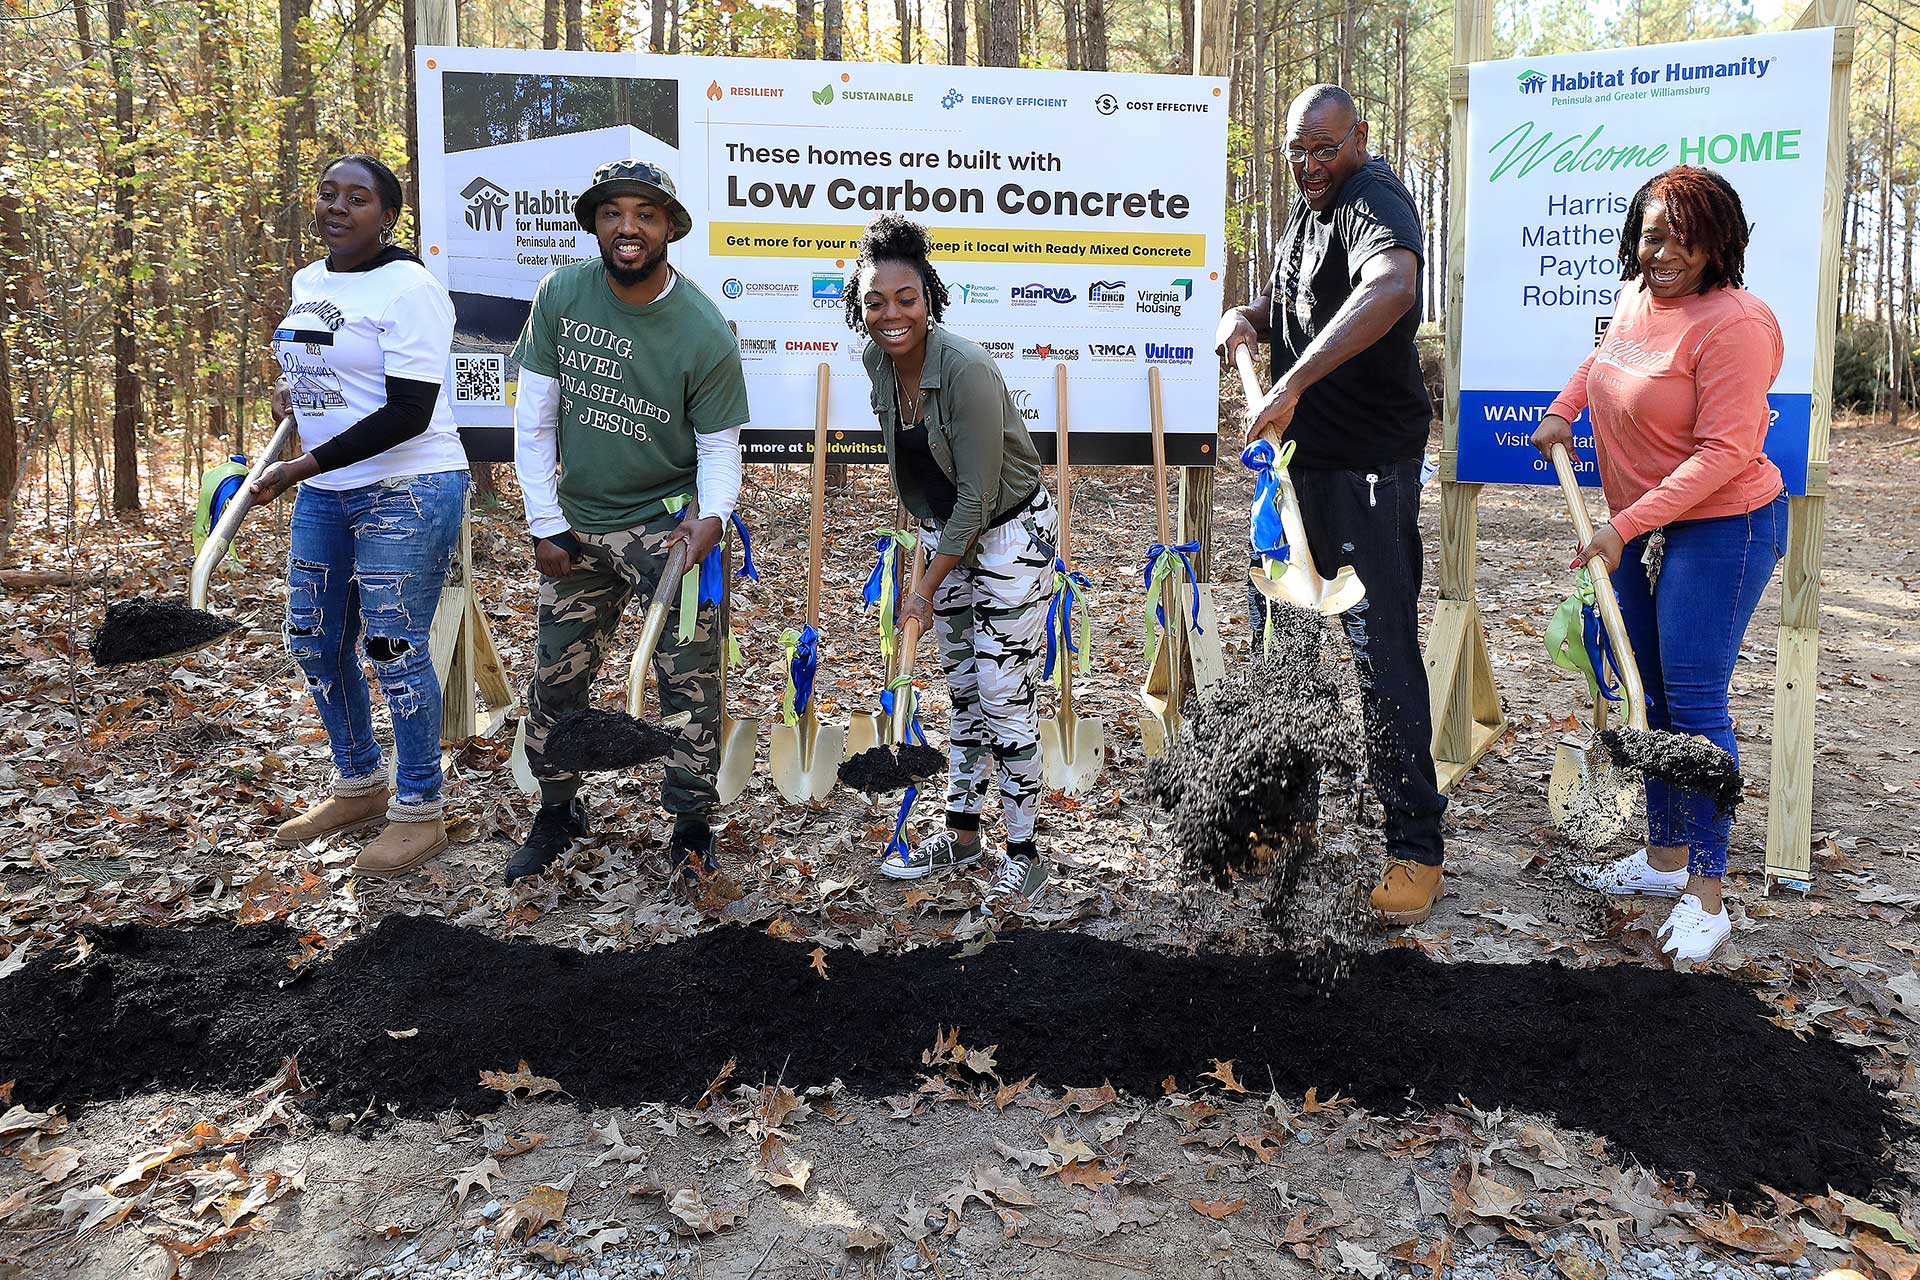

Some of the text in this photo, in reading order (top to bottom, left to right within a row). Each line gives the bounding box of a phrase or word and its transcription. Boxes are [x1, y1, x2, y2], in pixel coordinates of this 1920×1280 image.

[1551, 70, 1625, 92] Habitat
[1631, 67, 1660, 86] for
[730, 87, 784, 98] RESILIENT
[842, 91, 914, 102] SUSTAINABLE
[1551, 85, 1711, 106] Peninsula and Greater Williamsburg
[971, 95, 1068, 108] ENERGY EFFICIENT
[1126, 101, 1209, 113] COST EFFECTIVE
[726, 143, 1062, 172] These homes are built with
[1488, 121, 1802, 183] Welcome HOME
[515, 189, 579, 215] Habit
[727, 175, 1190, 219] Low Carbon Concrete
[1548, 192, 1628, 216] Harris
[515, 218, 583, 231] for Human
[516, 235, 576, 248] Peninsula and
[1522, 223, 1621, 247] Matthe
[726, 235, 750, 247] Get
[753, 238, 788, 248] more
[793, 236, 812, 248] for
[816, 239, 846, 251] your
[964, 240, 973, 252] it
[977, 241, 1009, 253] local
[1012, 242, 1042, 254] with
[1046, 243, 1087, 256] Ready
[1089, 244, 1129, 256] Mixed
[1132, 245, 1191, 257] Concrete
[517, 253, 548, 265] Greater
[745, 283, 800, 292] CONSOCIATE
[1011, 286, 1075, 302] PlanRVA
[813, 300, 843, 309] CPDC
[1101, 293, 1125, 302] DHCD
[1137, 290, 1179, 305] Virginia
[1136, 302, 1182, 317] Housing
[785, 341, 839, 351] CHANEY
[979, 342, 1014, 351] GUSON
[1088, 344, 1136, 356] VRMCA
[1145, 343, 1194, 359] Vulcan
[579, 406, 652, 442] JESUS.
[1495, 432, 1530, 447] Visit
[750, 443, 785, 453] more
[788, 442, 803, 453] at
